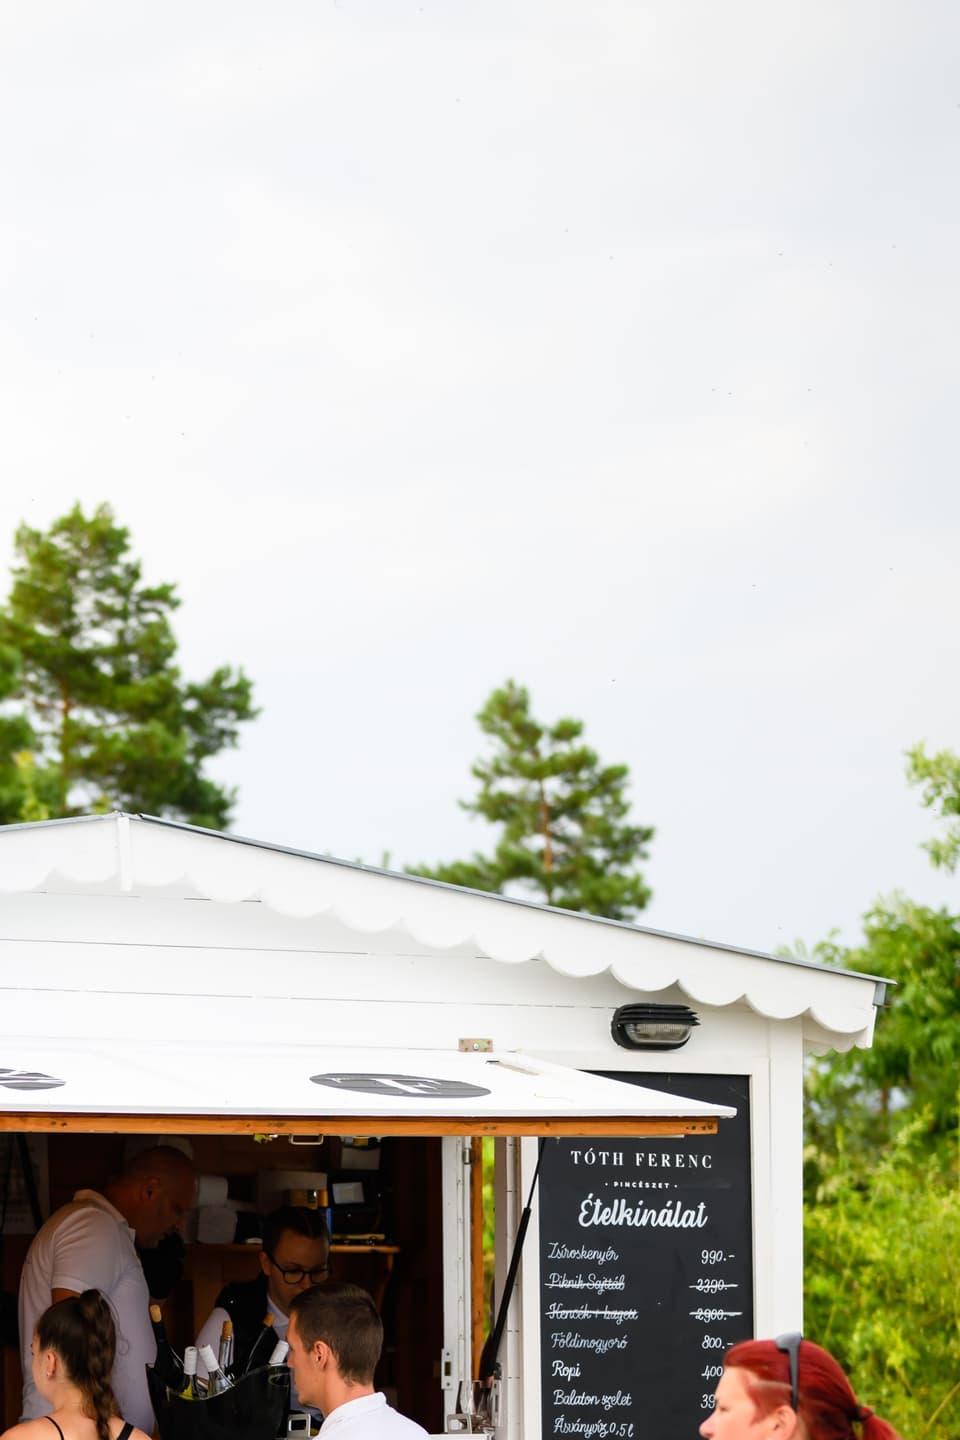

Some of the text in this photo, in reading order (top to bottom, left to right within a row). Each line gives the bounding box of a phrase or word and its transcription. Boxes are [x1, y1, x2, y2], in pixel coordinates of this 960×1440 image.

[571, 1148, 711, 1168] TÓTH FERENC
[614, 1181, 669, 1189] PINCÉSZET
[548, 1242, 619, 1265] Zsíroskenyér
[551, 1332, 628, 1353] Földimogyoró
[552, 1360, 581, 1382] Ropi
[553, 1389, 632, 1410] Balaton szelet
[554, 1414, 609, 1438] Ásványvíz
